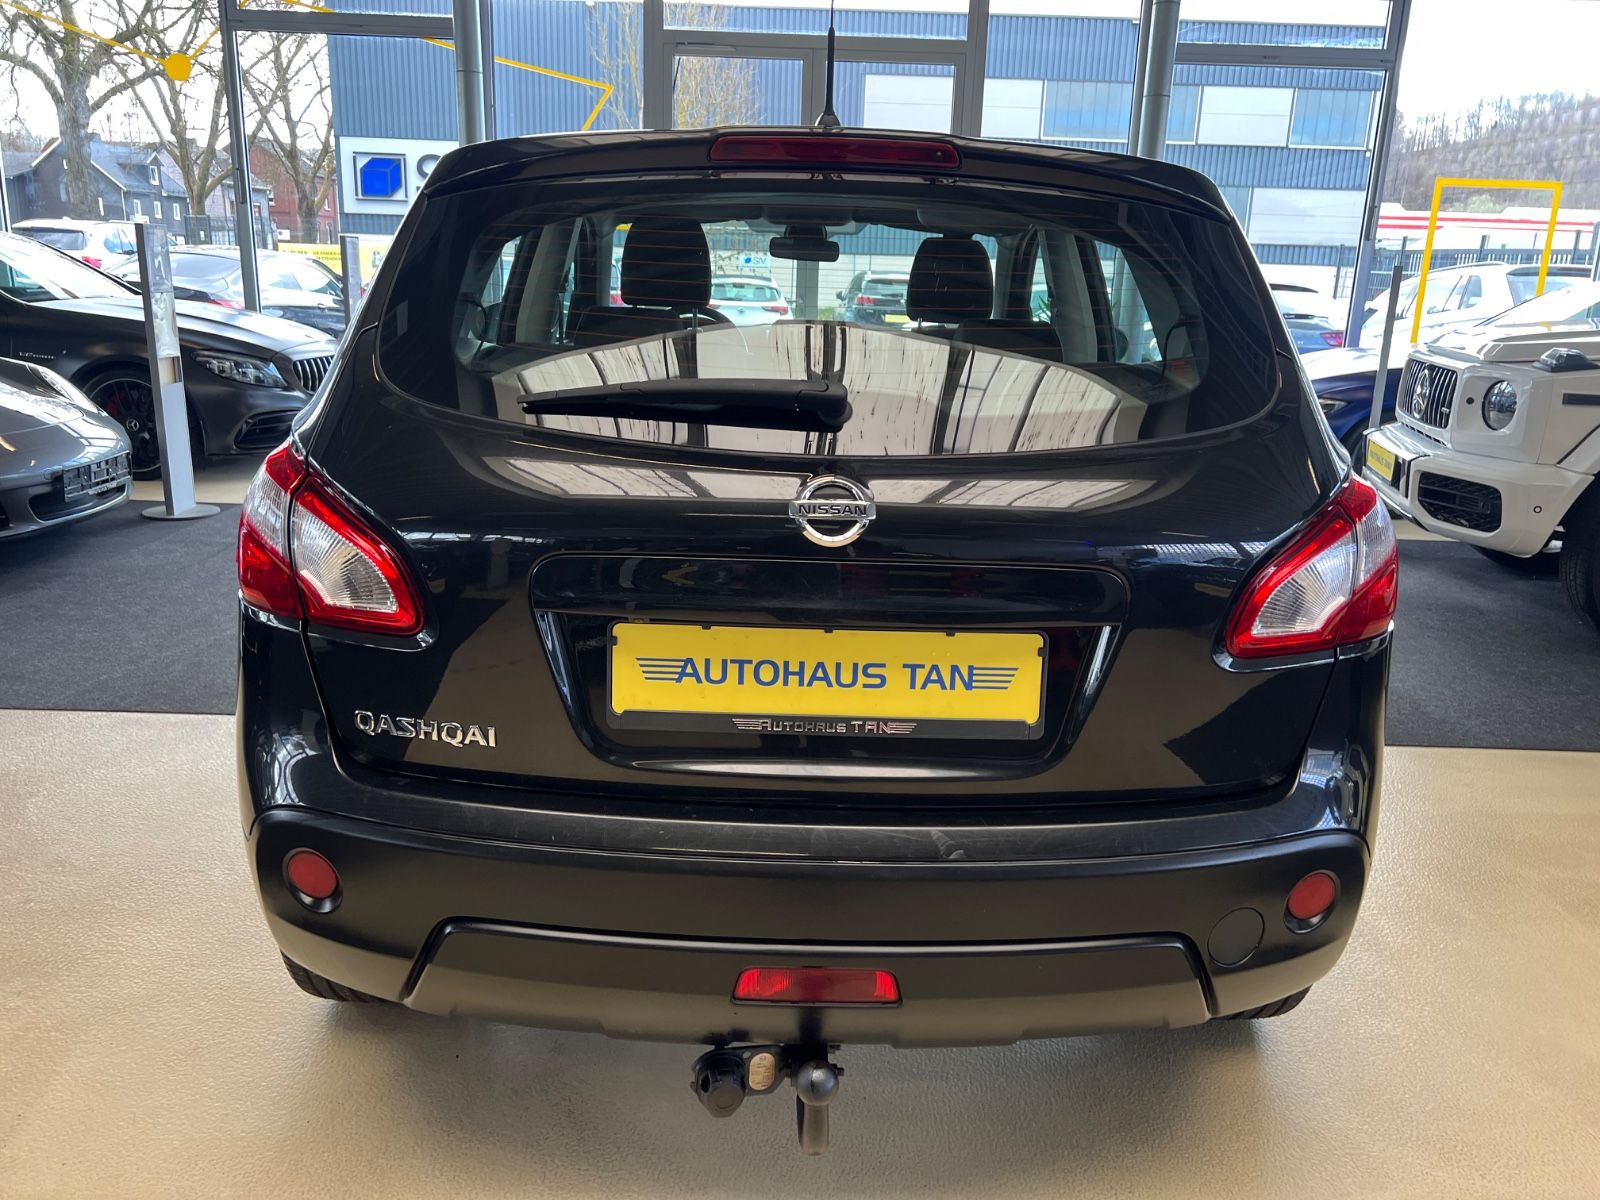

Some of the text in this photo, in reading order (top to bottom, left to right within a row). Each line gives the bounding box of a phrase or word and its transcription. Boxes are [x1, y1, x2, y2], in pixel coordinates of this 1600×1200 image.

[799, 504, 867, 516] NISSAN
[675, 657, 975, 691] AUTOHAUS TAN
[354, 709, 497, 748] QASHQAI
[850, 720, 891, 734] TAN
